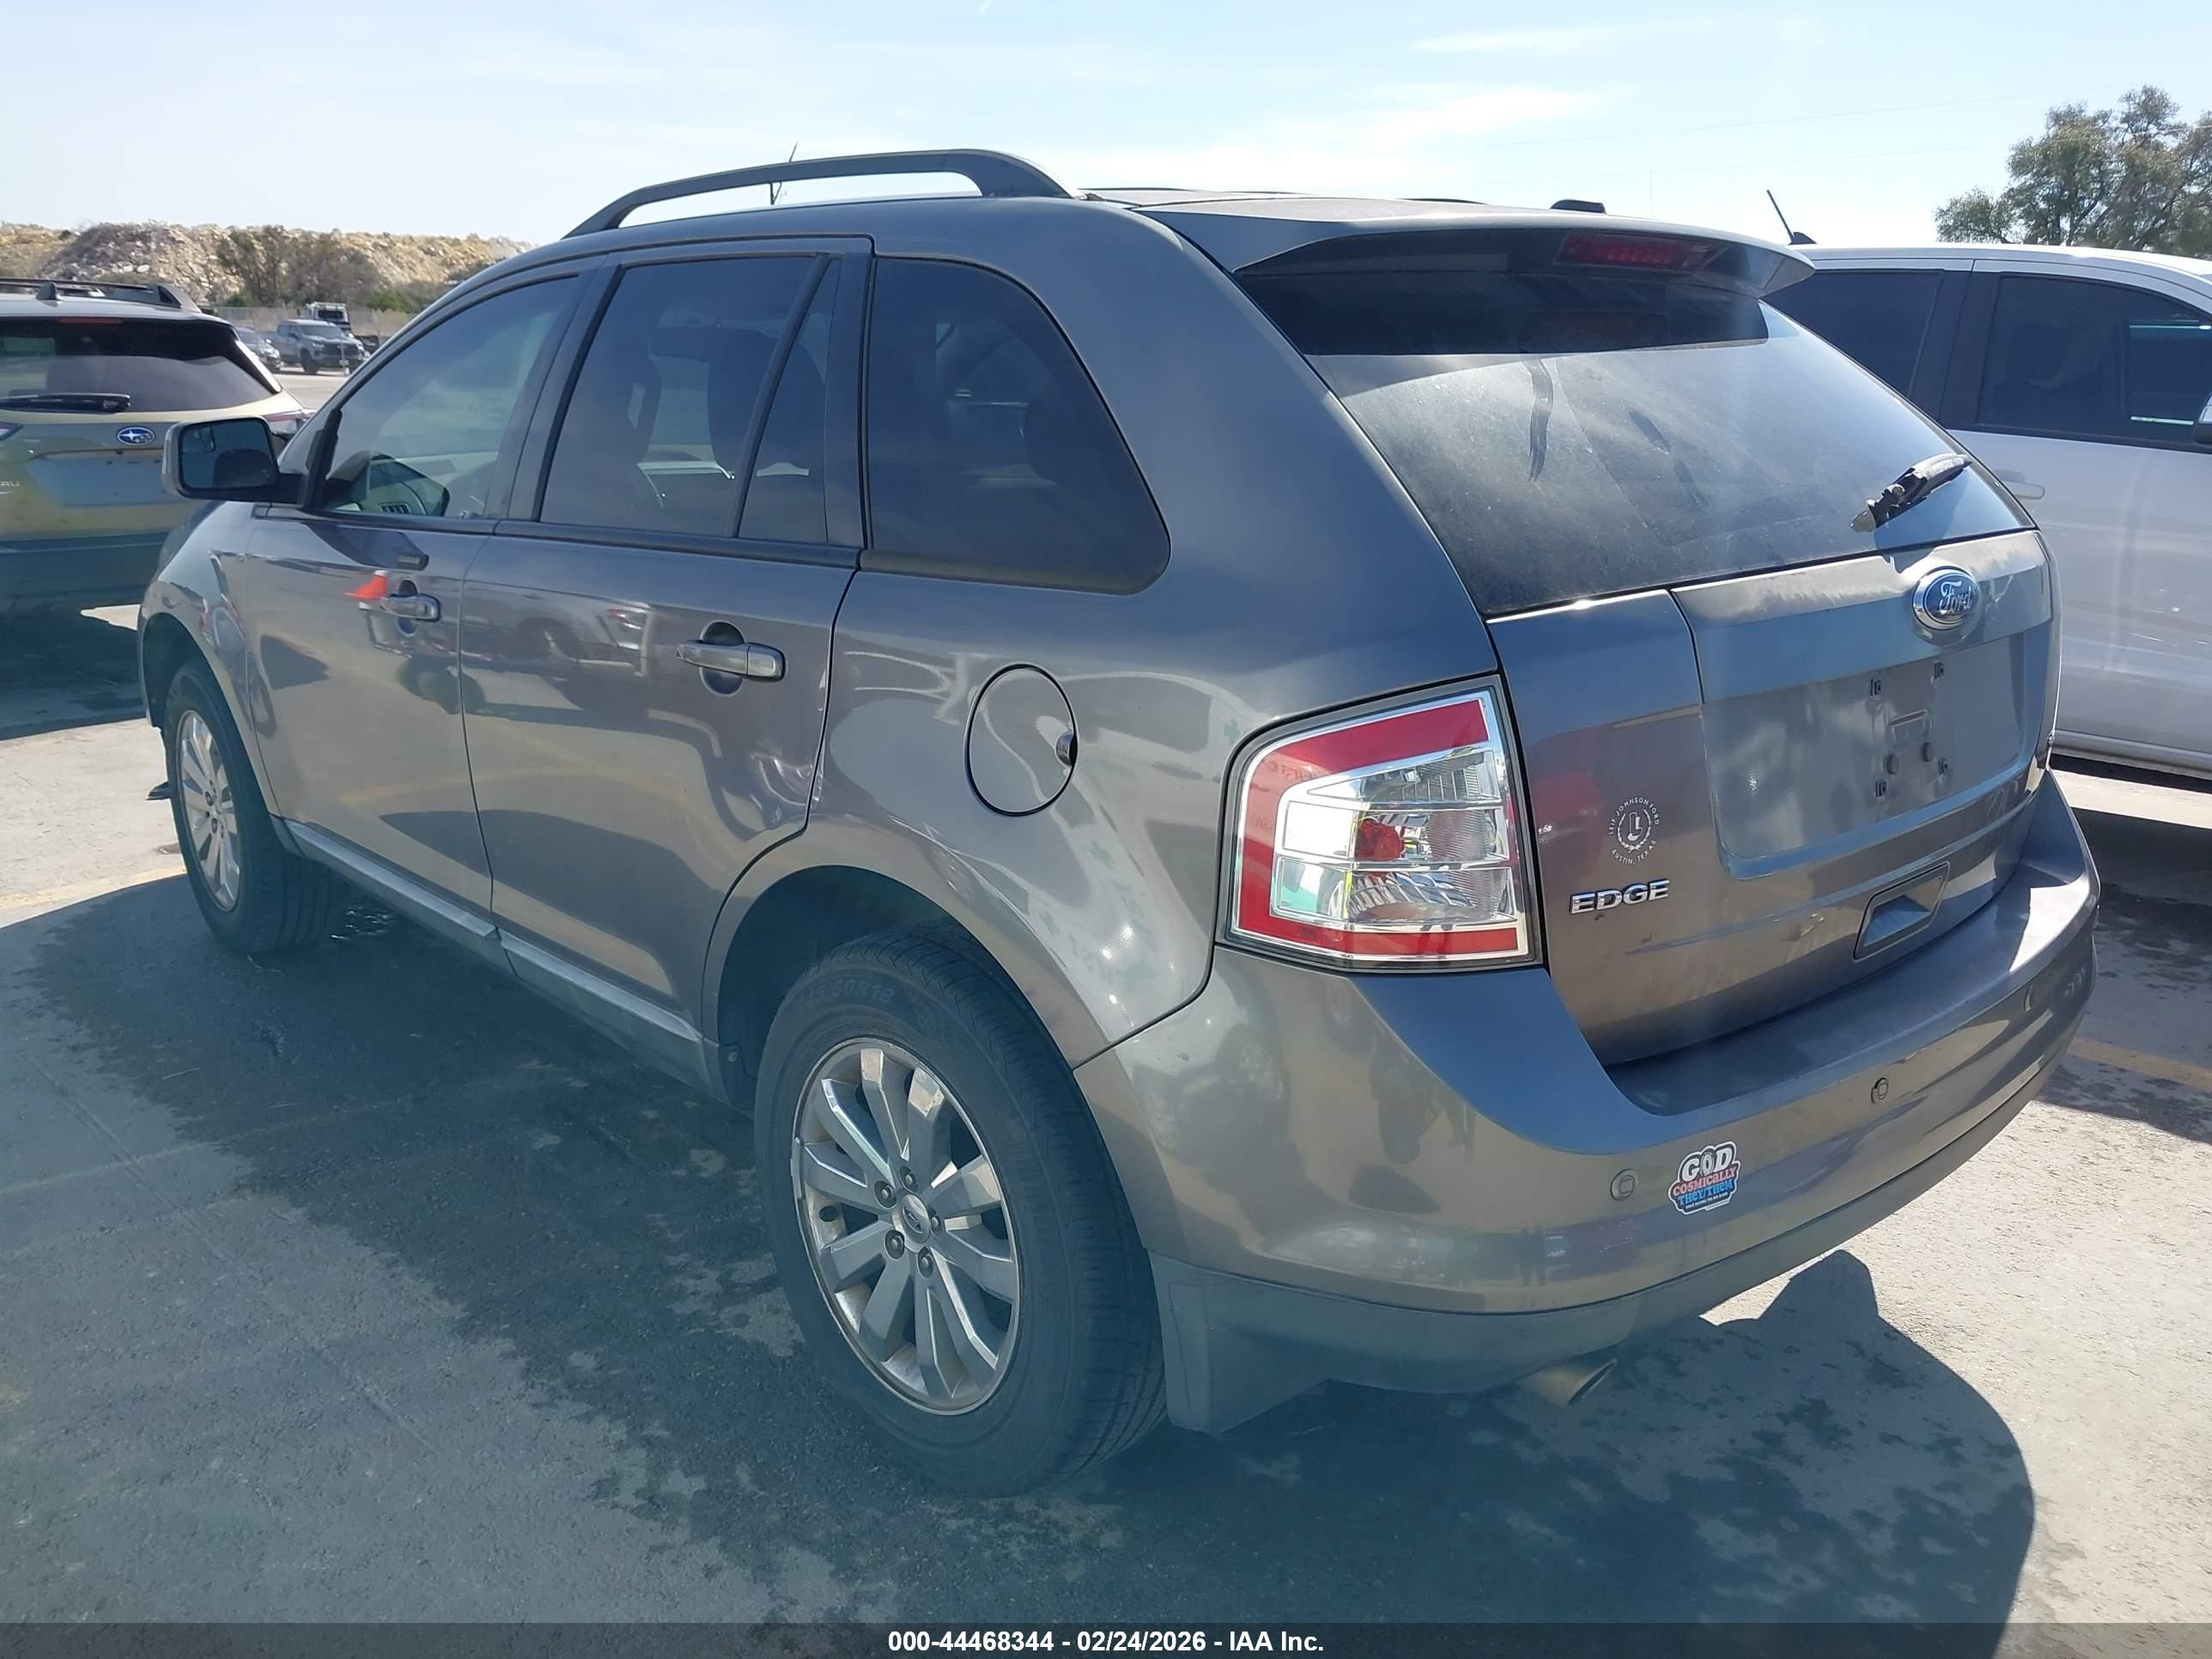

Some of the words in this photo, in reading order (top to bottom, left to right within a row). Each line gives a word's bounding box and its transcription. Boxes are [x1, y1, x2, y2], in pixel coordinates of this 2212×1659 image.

[1940, 580, 1972, 615] Ford
[1616, 797, 1649, 817] JOHNSON
[1650, 804, 1660, 825] FORD
[1637, 839, 1656, 862] TEXAS
[1569, 878, 1670, 915] EDGE
[1682, 1147, 1733, 1182] GOD
